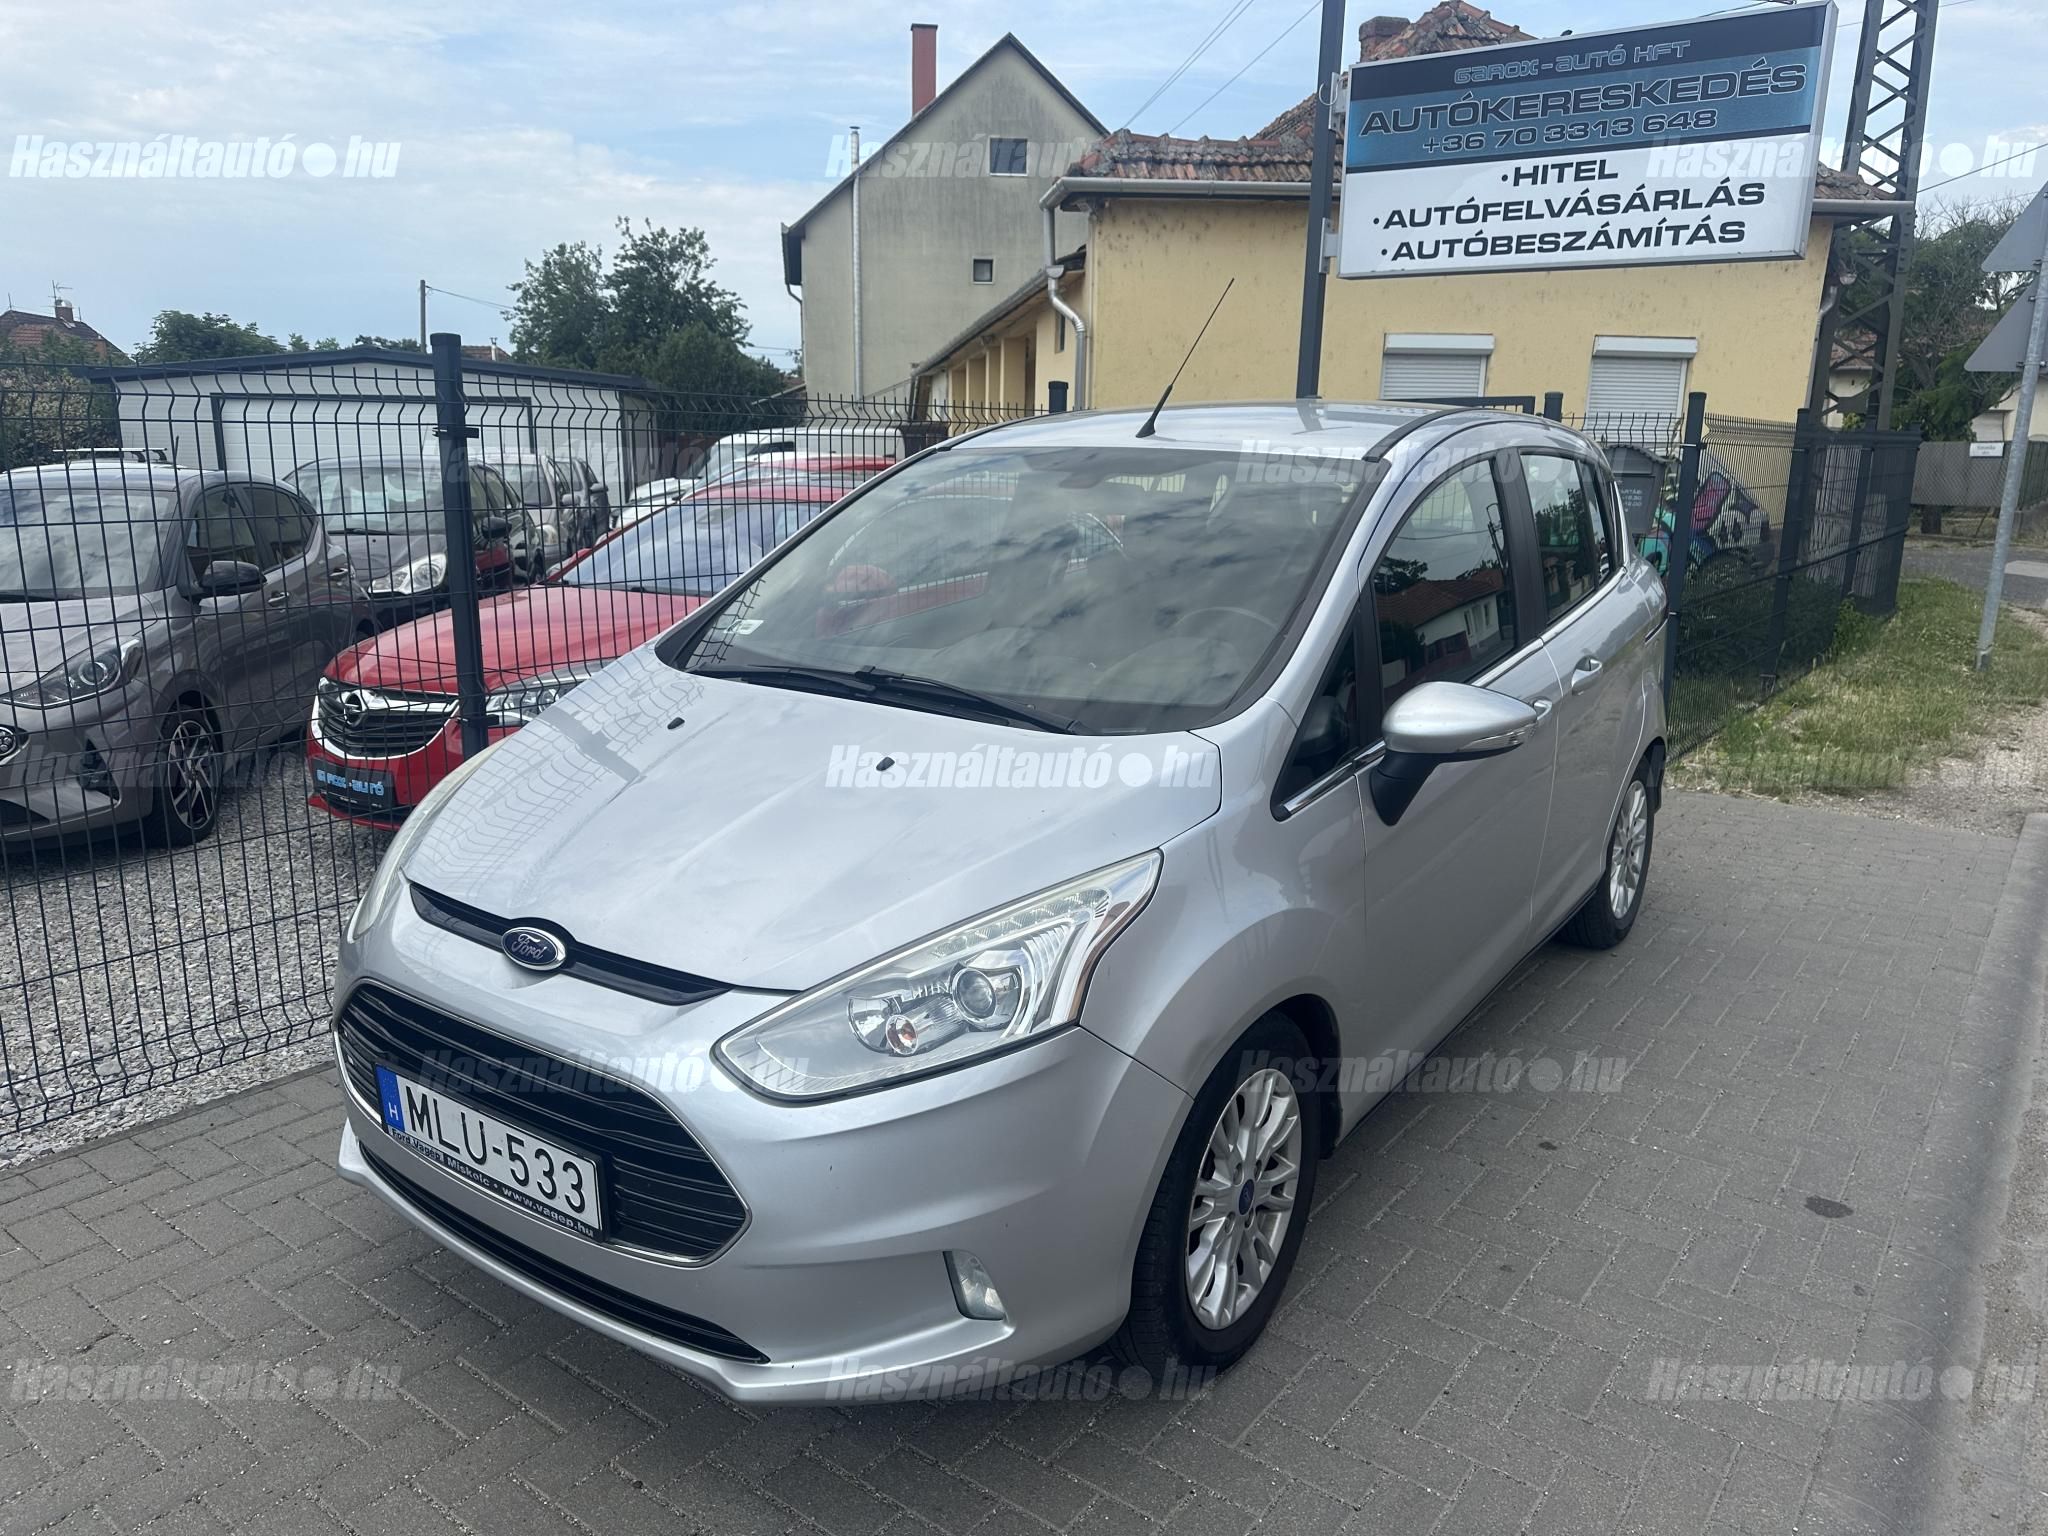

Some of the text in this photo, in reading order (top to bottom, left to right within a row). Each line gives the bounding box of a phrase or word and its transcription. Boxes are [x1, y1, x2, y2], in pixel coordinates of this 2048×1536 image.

[1359, 58, 1807, 137] AUTÓKERESKEDÉS
[1422, 109, 1718, 154] +36 70 3313 648
[511, 933, 548, 960] Ford
[388, 1102, 400, 1121] H
[405, 1085, 587, 1215] MLU-533
[447, 1156, 490, 1187] Miskolc
[501, 1186, 594, 1238] www.vagep.hu
